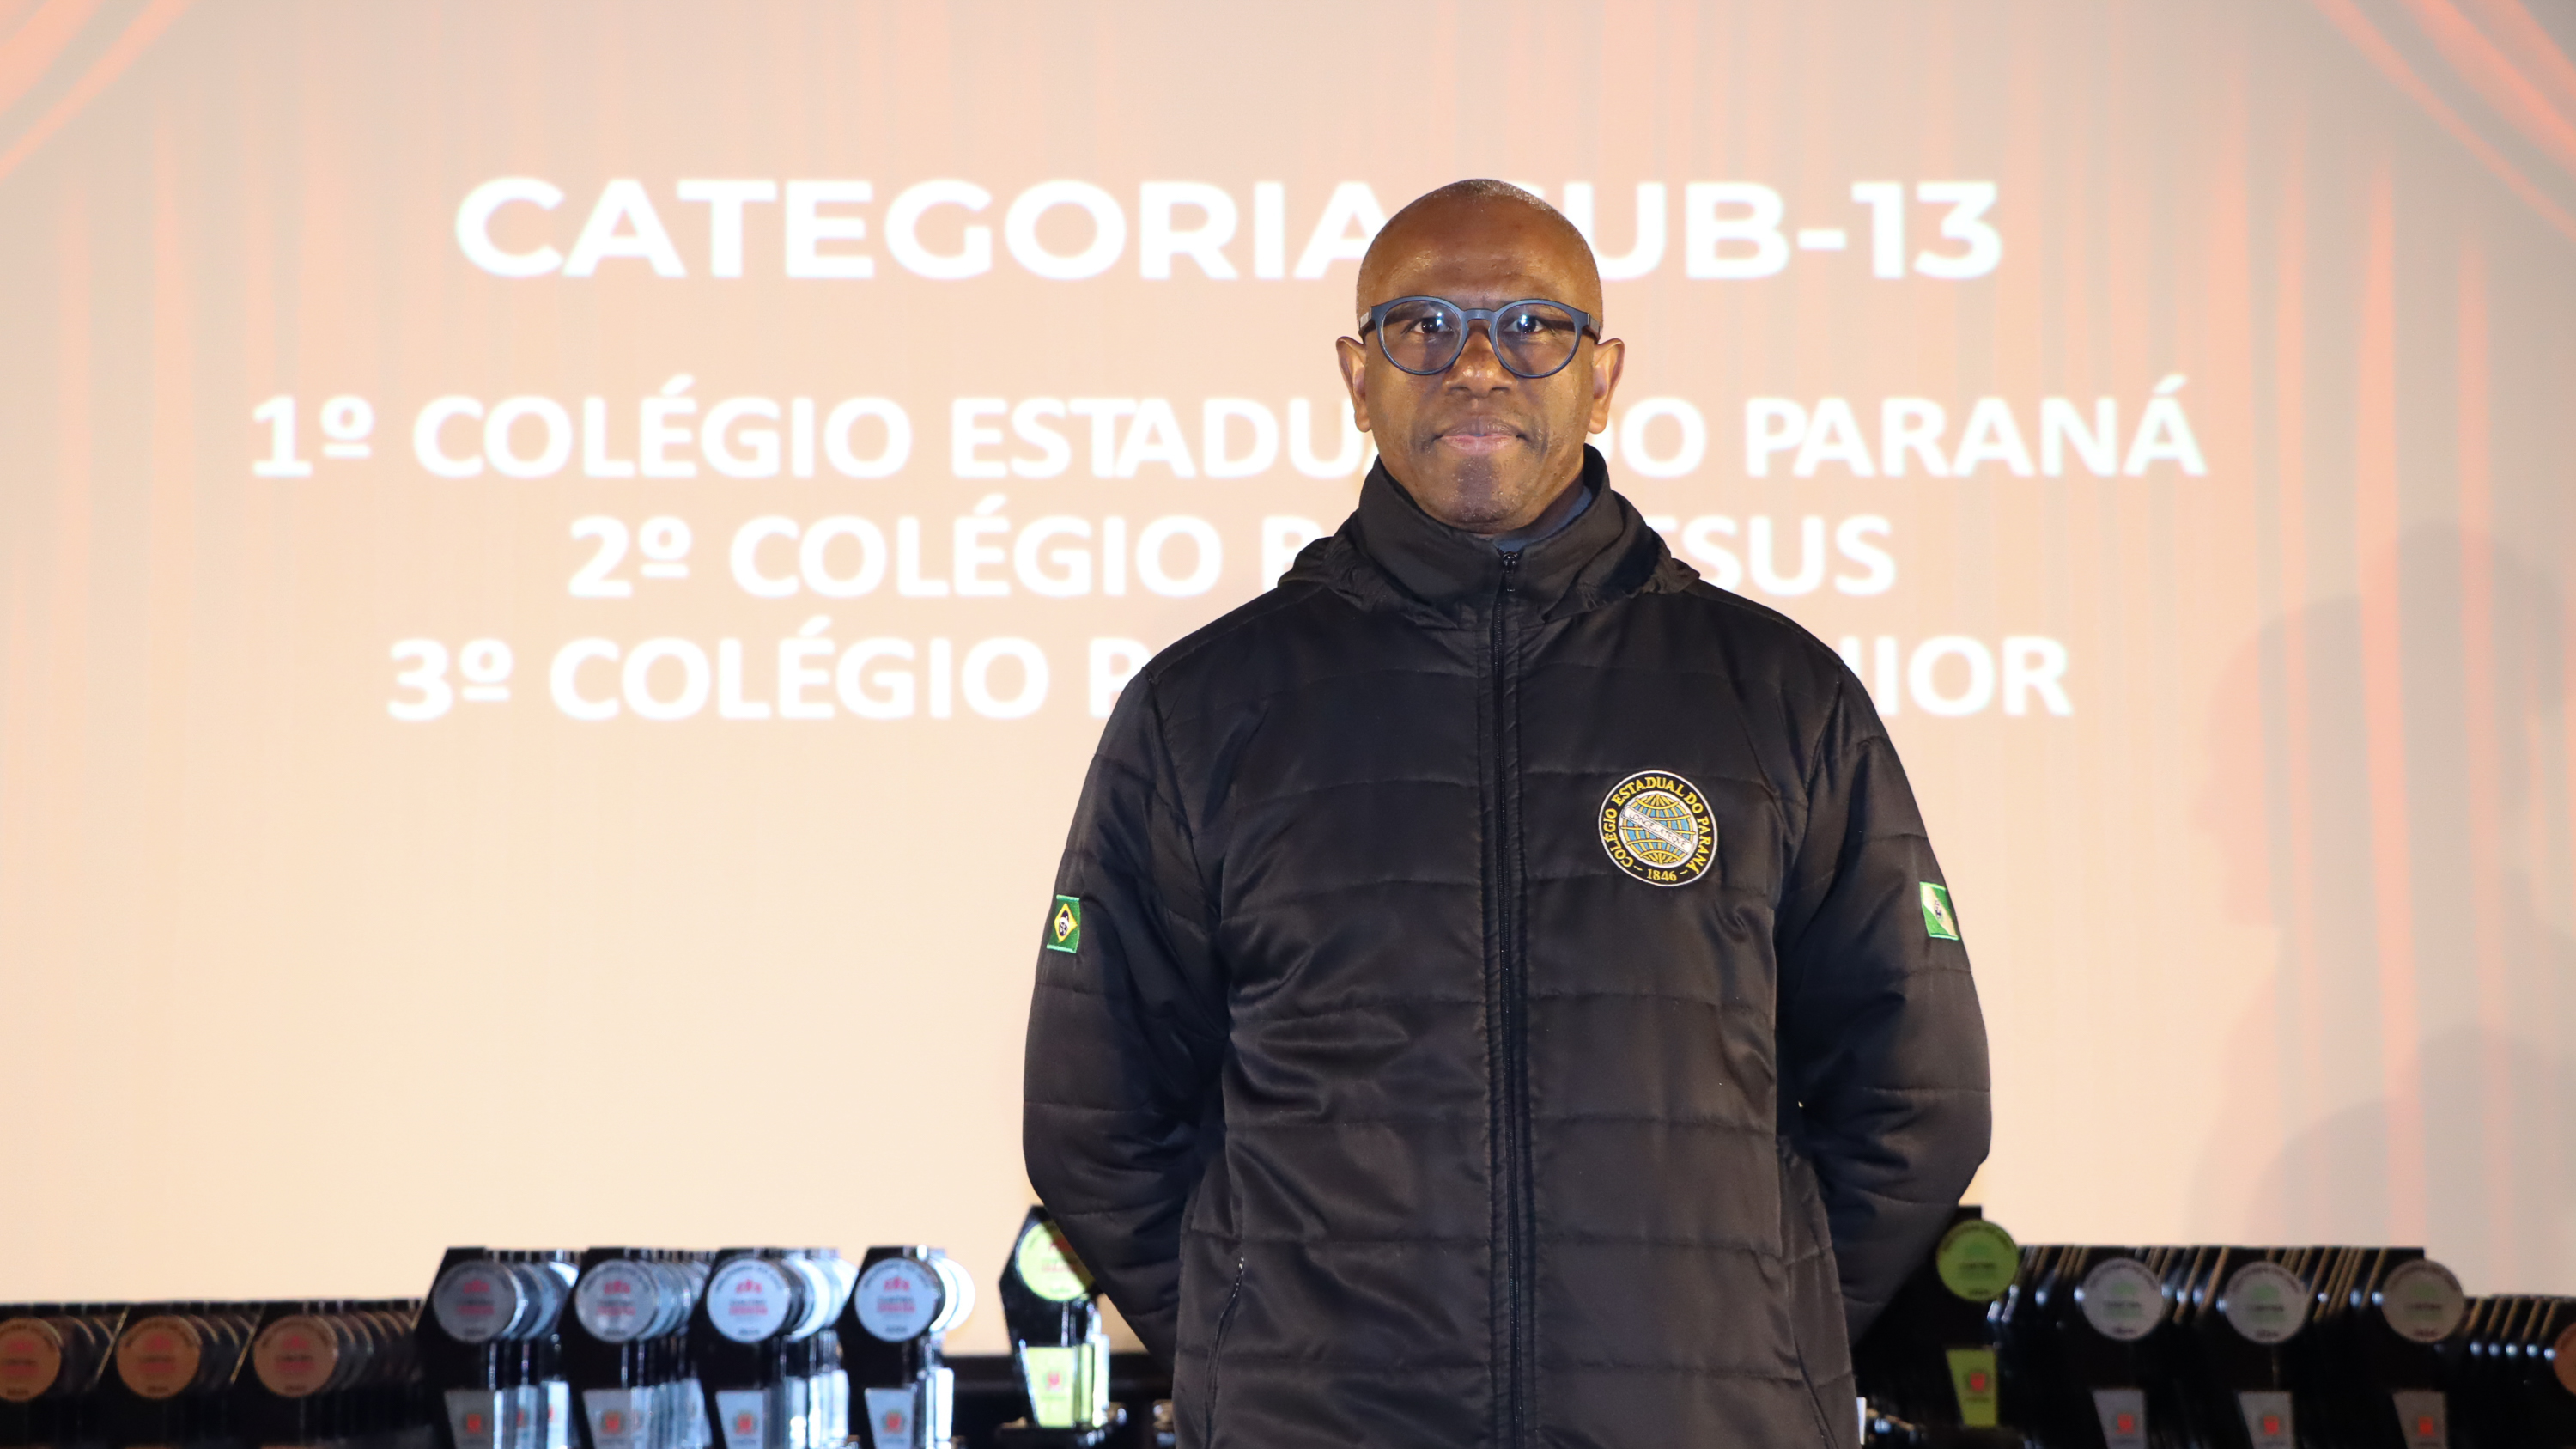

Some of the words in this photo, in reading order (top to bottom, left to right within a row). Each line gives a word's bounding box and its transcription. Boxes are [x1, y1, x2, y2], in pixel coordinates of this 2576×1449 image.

[455, 177, 1388, 281] CATEGORIA
[1509, 182, 2003, 281] UB-13
[253, 396, 373, 478] 1º
[413, 374, 914, 479] COLÉGIO
[951, 396, 1379, 479] ESTADU
[1745, 375, 2206, 478] PARANÁ
[568, 516, 694, 598] 2º
[730, 493, 1224, 599] COLÉGIO
[1643, 515, 1896, 597] SUS
[388, 638, 514, 721] 3º
[550, 626, 1050, 722] COLÉGIO
[1612, 776, 1685, 806] ESTADUAL
[1685, 792, 1704, 813] DO
[1647, 868, 1677, 881] 1846
